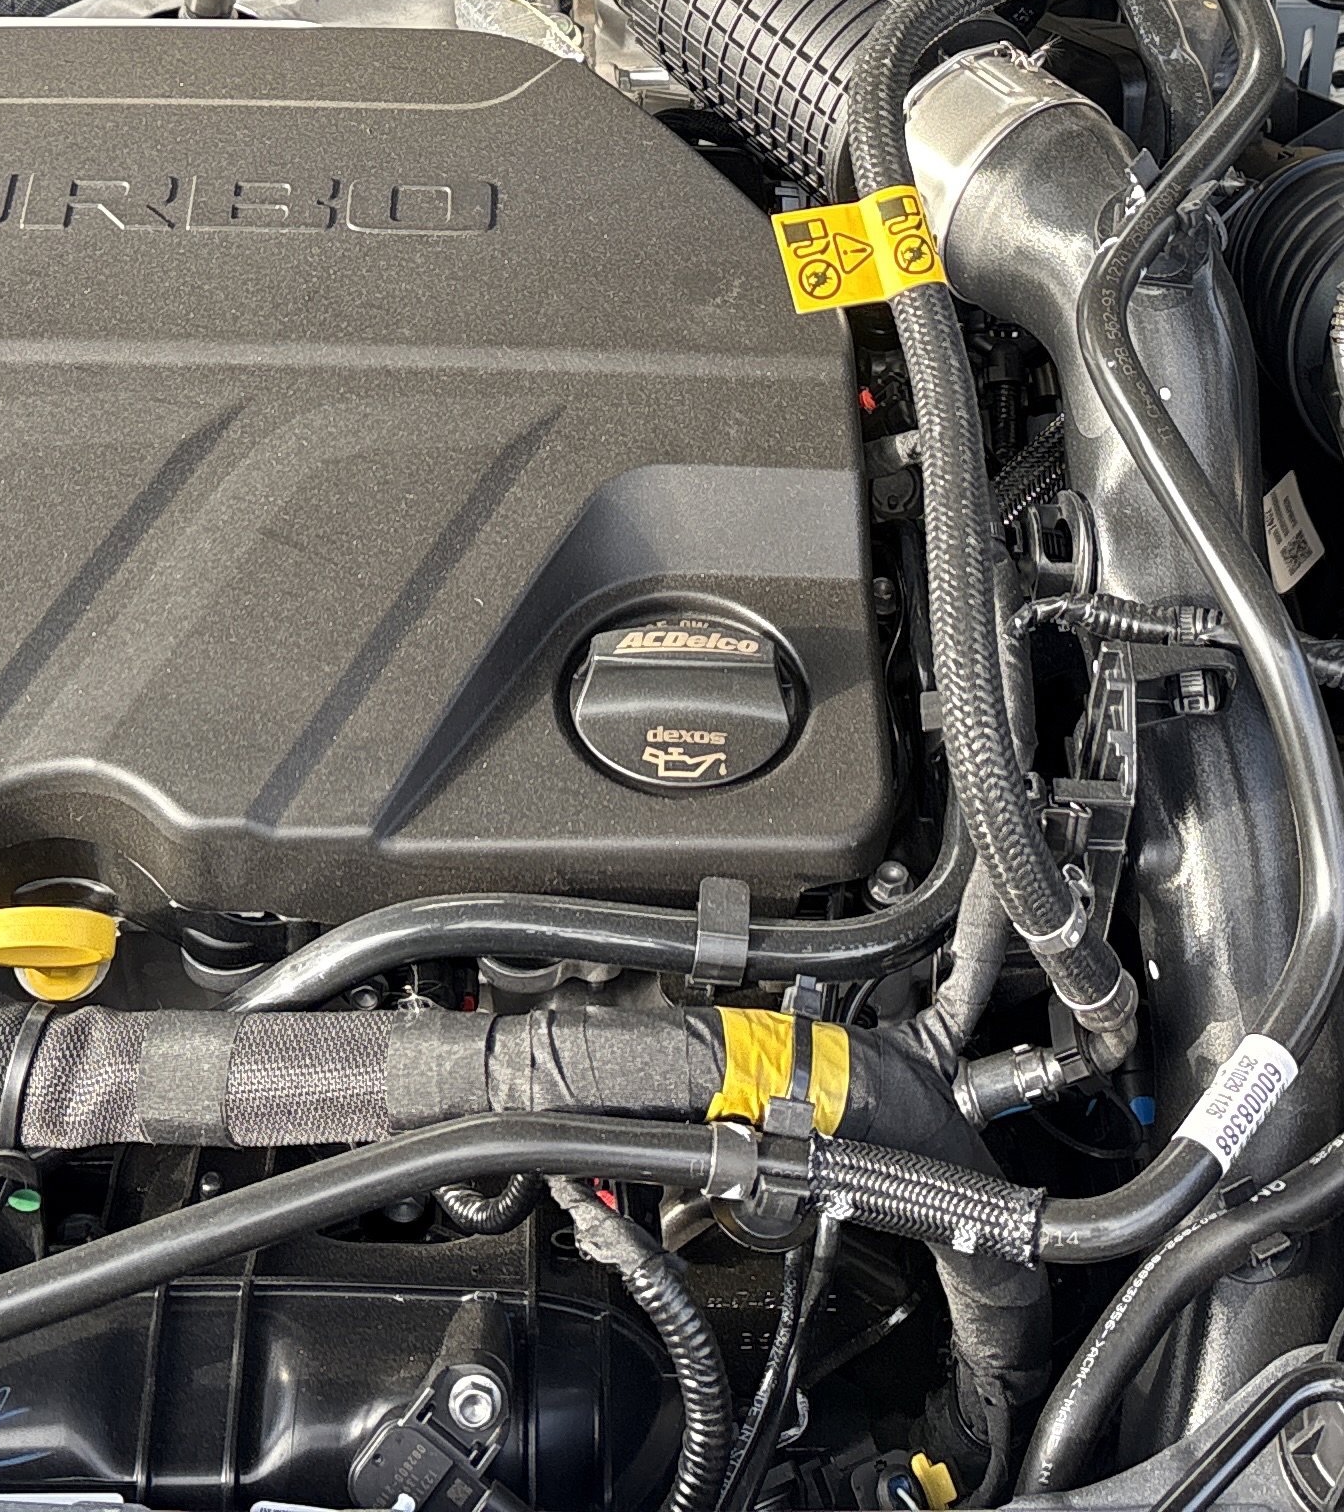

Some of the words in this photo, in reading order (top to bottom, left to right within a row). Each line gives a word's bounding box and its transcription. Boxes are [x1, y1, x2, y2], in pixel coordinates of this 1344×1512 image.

[614, 631, 760, 653] ACDelco
[645, 724, 729, 745] dexos
[1215, 1062, 1283, 1157] 60008388
